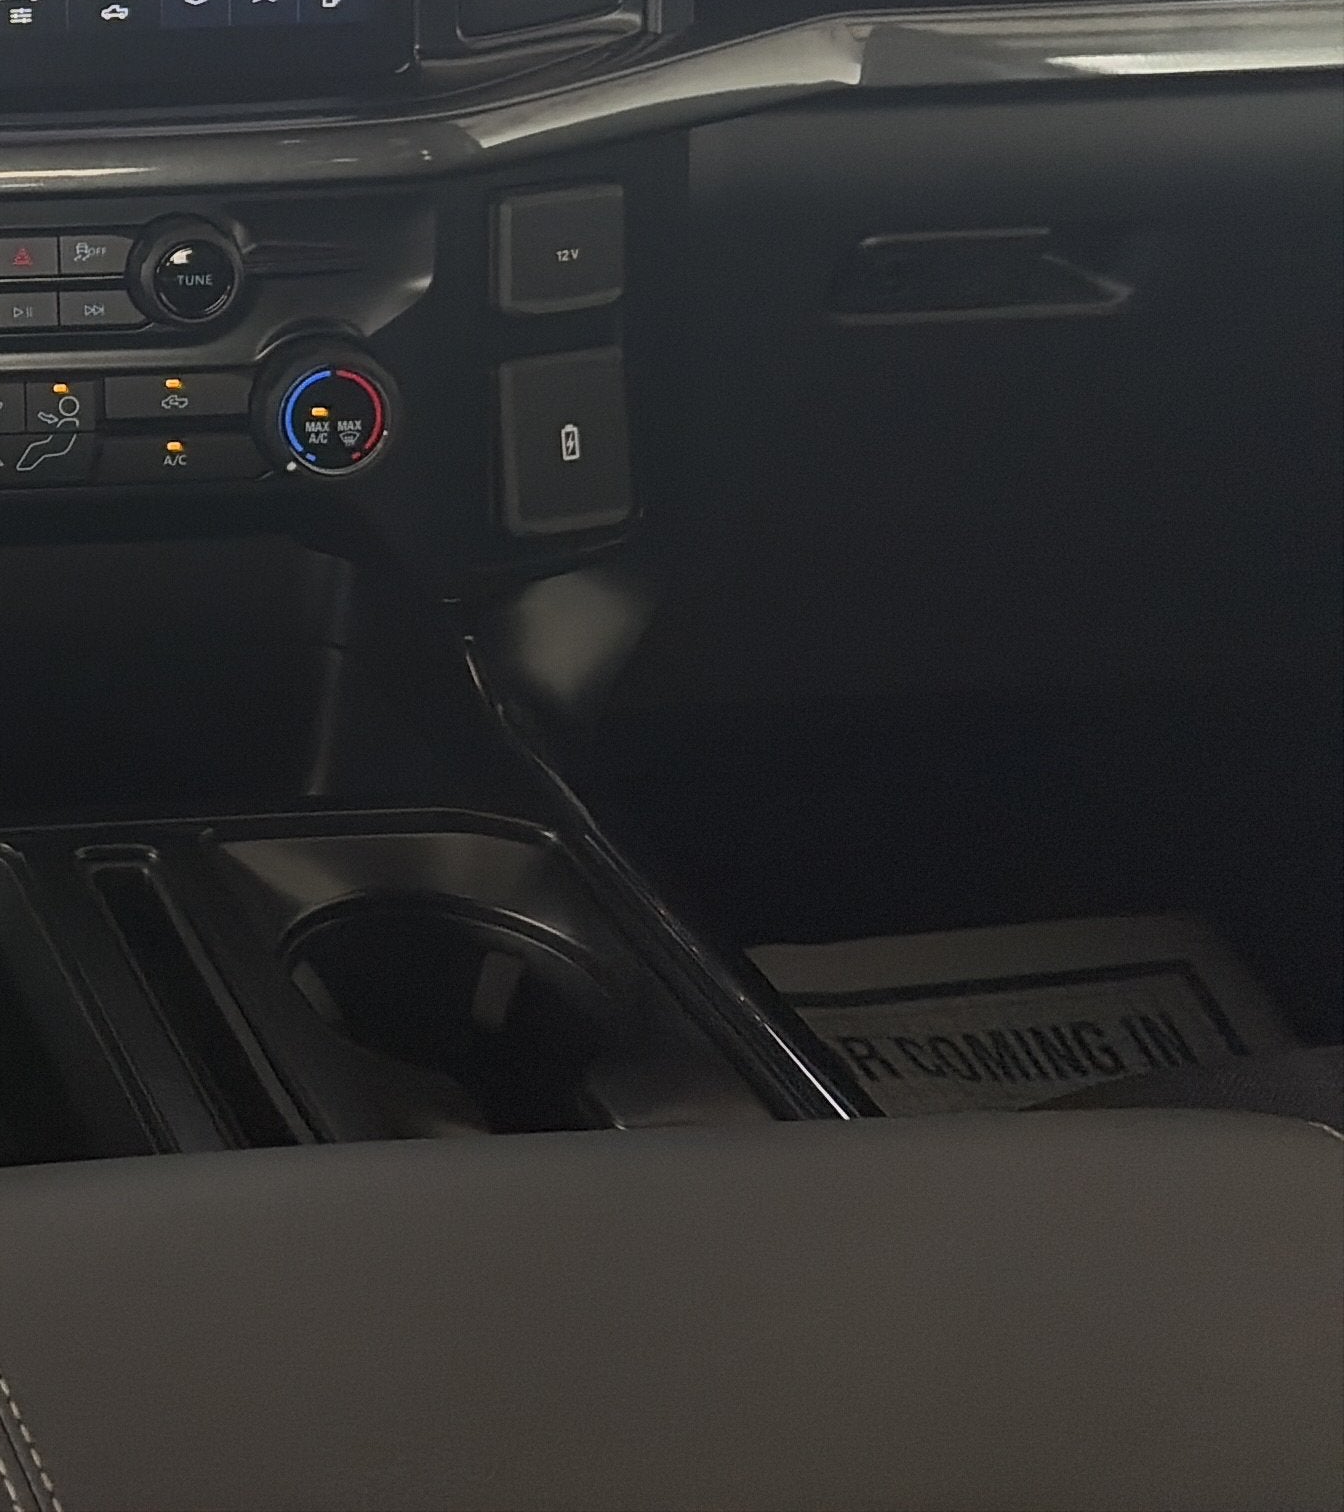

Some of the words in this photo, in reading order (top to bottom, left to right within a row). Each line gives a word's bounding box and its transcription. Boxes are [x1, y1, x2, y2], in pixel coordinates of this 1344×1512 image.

[89, 246, 107, 256] OFF
[176, 274, 213, 286] TUNE
[306, 421, 330, 432] MAX
[338, 419, 362, 431] MAX
[309, 433, 328, 444] A/C
[163, 454, 187, 466] A/C
[890, 1019, 1127, 1083] COMING
[1122, 1011, 1200, 1069] IN
